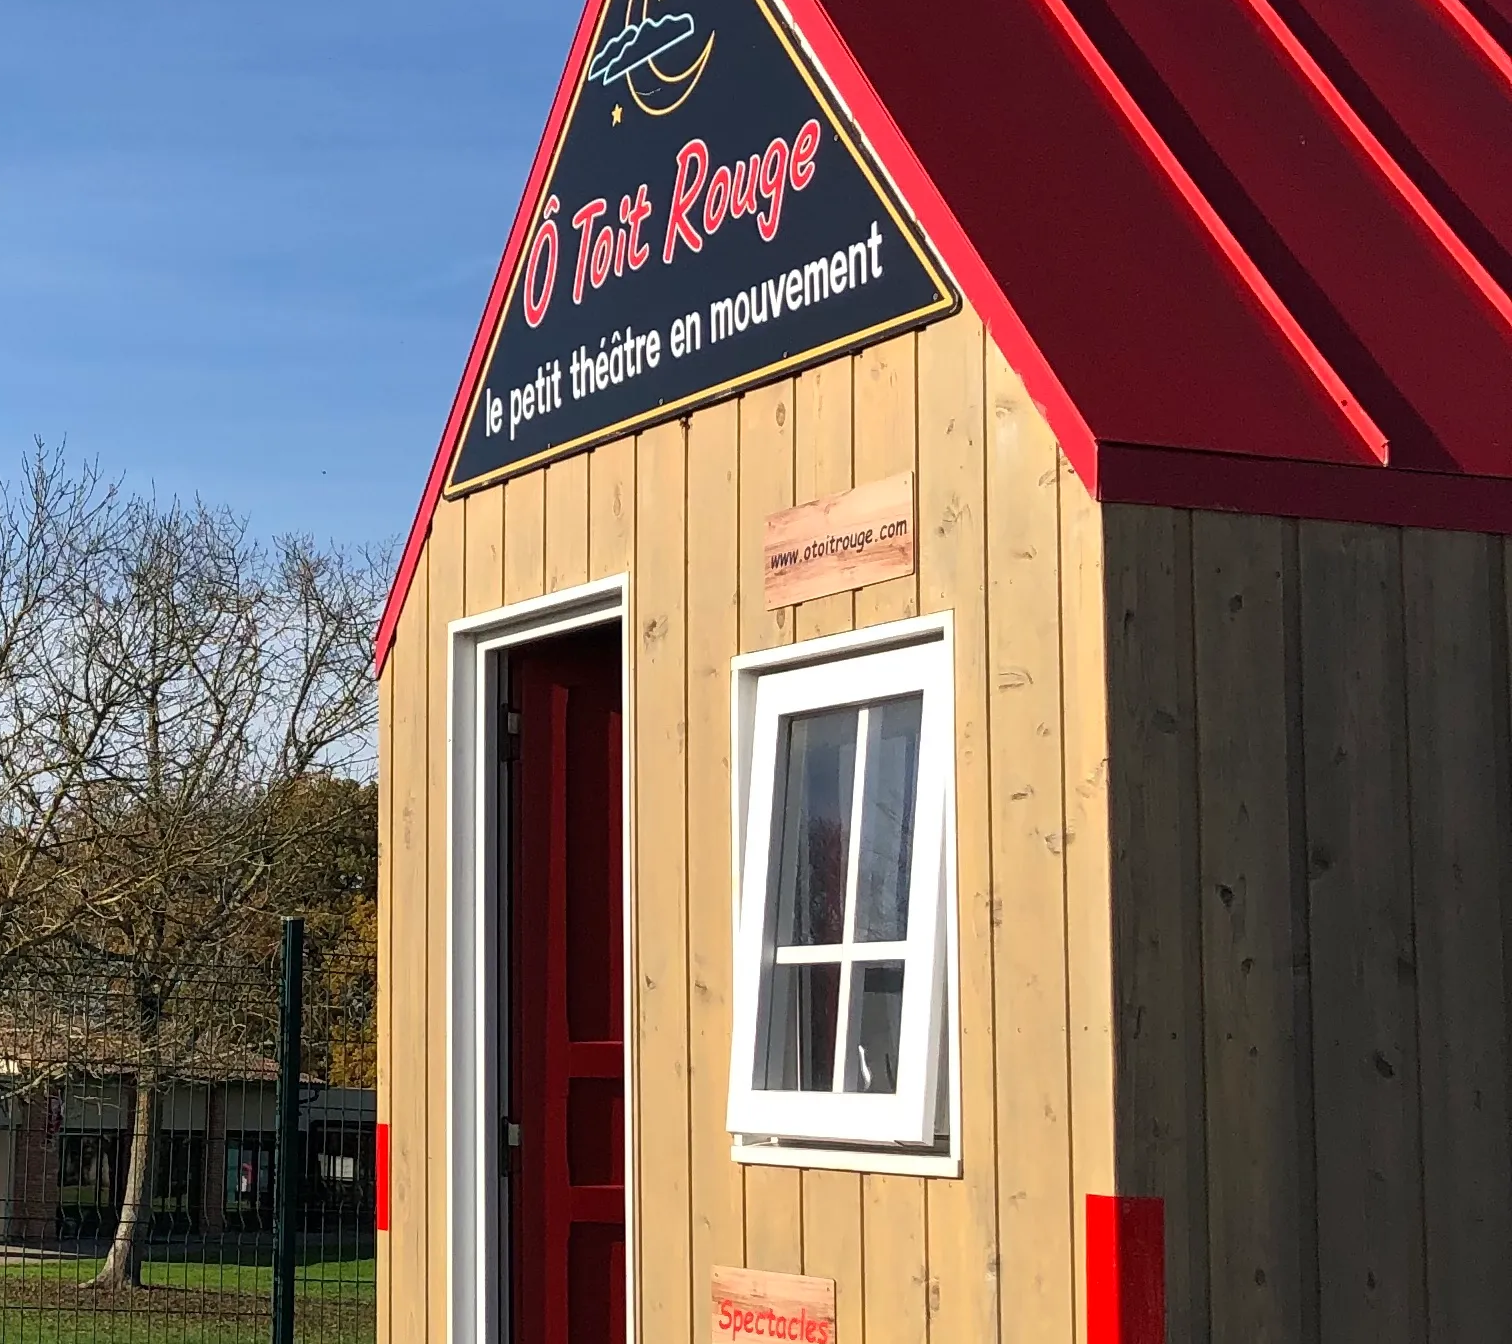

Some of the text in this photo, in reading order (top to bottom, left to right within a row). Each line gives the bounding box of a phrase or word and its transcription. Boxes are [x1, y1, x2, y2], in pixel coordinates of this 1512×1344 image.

[523, 119, 822, 327] Ô Toit Rouge
[485, 221, 884, 441] le petit théâtre en mouvement
[770, 519, 908, 570] www.otoitrouge.com
[718, 1299, 829, 1344] Spectacles
